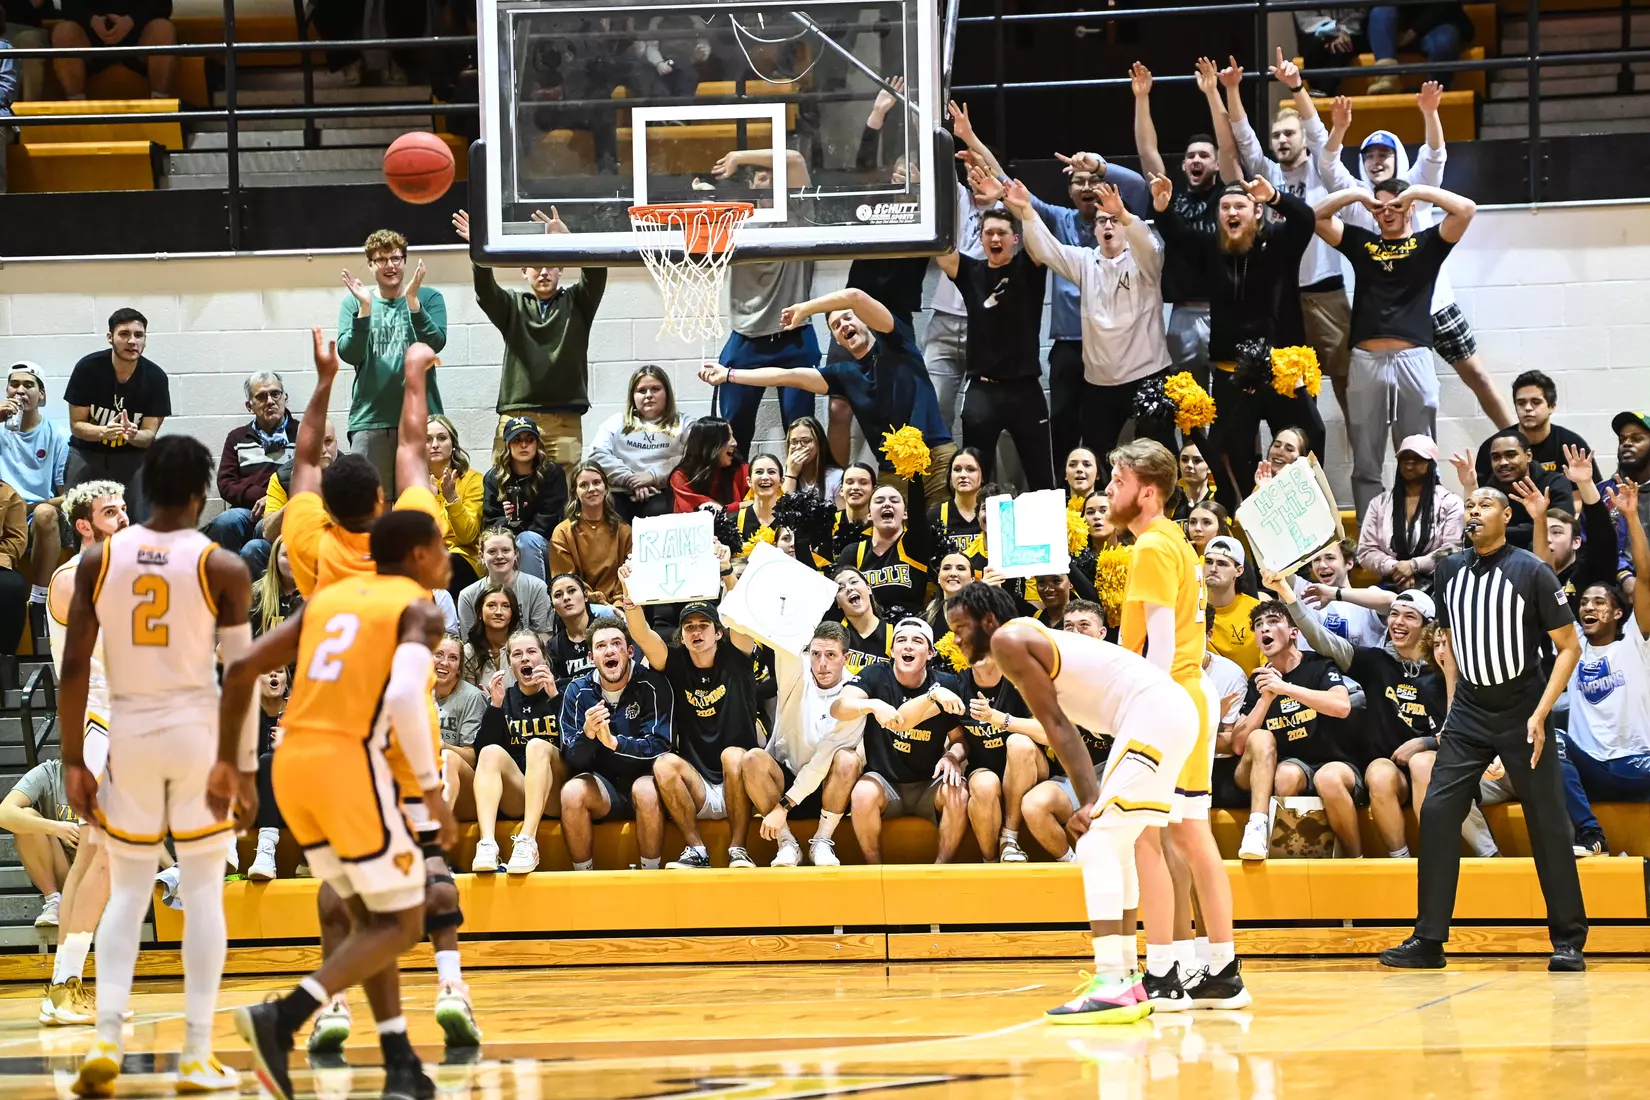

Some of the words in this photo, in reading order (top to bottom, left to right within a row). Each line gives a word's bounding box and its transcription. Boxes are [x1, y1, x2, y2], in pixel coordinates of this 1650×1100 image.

[873, 203, 918, 214] SCHUTT
[371, 326, 409, 342] RANGE
[626, 440, 670, 450] MARAUDERS
[1253, 467, 1302, 517] HOLD
[1261, 481, 1316, 536] THIS
[639, 525, 712, 563] RAMS
[999, 500, 1050, 567] L
[1288, 521, 1318, 553] L
[137, 550, 169, 561] PSAC
[863, 564, 912, 588] ILLE
[132, 573, 170, 647] 2
[307, 612, 360, 682] 2
[1328, 672, 1342, 682] 21
[505, 715, 559, 738] VILLE
[1287, 727, 1308, 741] 2021
[983, 737, 1004, 749] 2021
